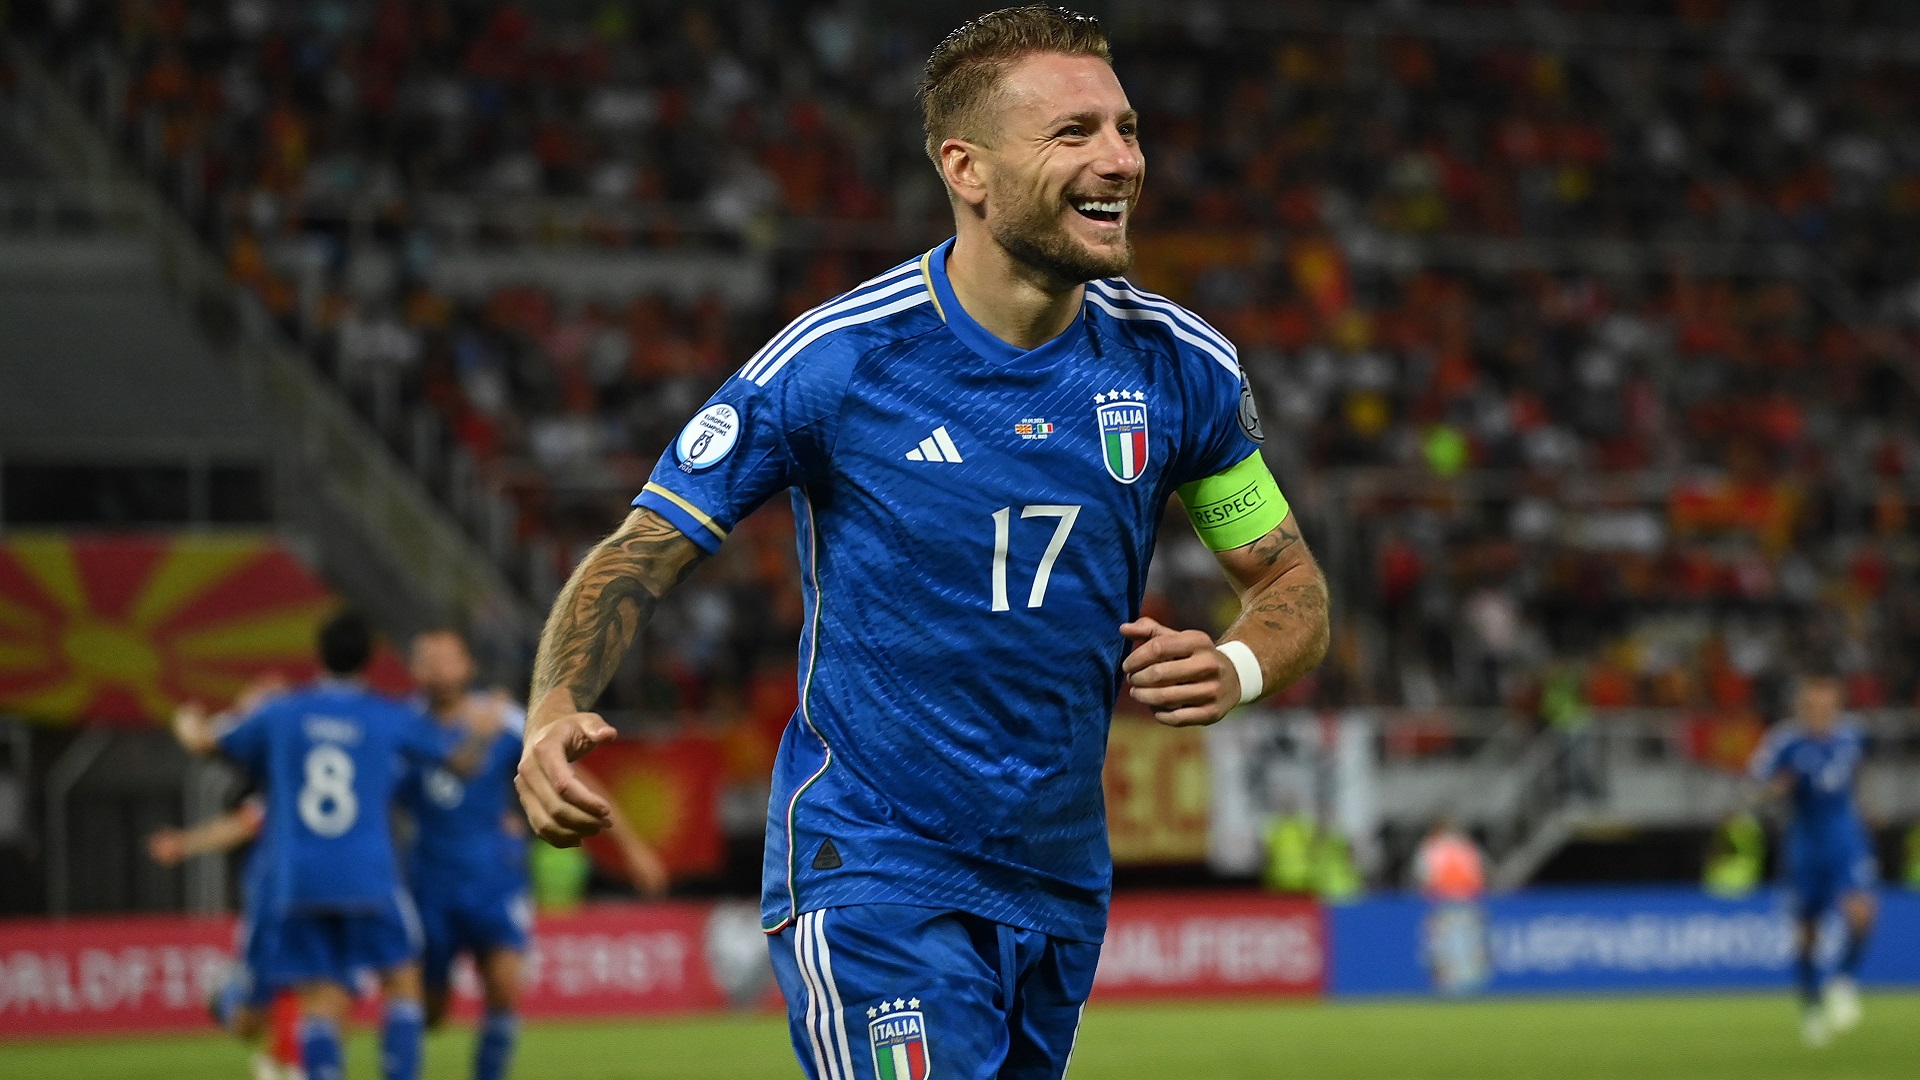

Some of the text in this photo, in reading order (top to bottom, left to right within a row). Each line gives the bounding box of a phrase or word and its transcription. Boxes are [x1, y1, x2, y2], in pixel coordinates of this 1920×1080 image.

[700, 420, 727, 436] CHAMPIONS
[704, 413, 732, 430] EUROPEAN
[1102, 409, 1144, 426] ITALIA
[1194, 485, 1262, 525] RESPECT
[991, 505, 1082, 612] 17
[299, 745, 359, 838] 8
[873, 1018, 920, 1041] ITALIA
